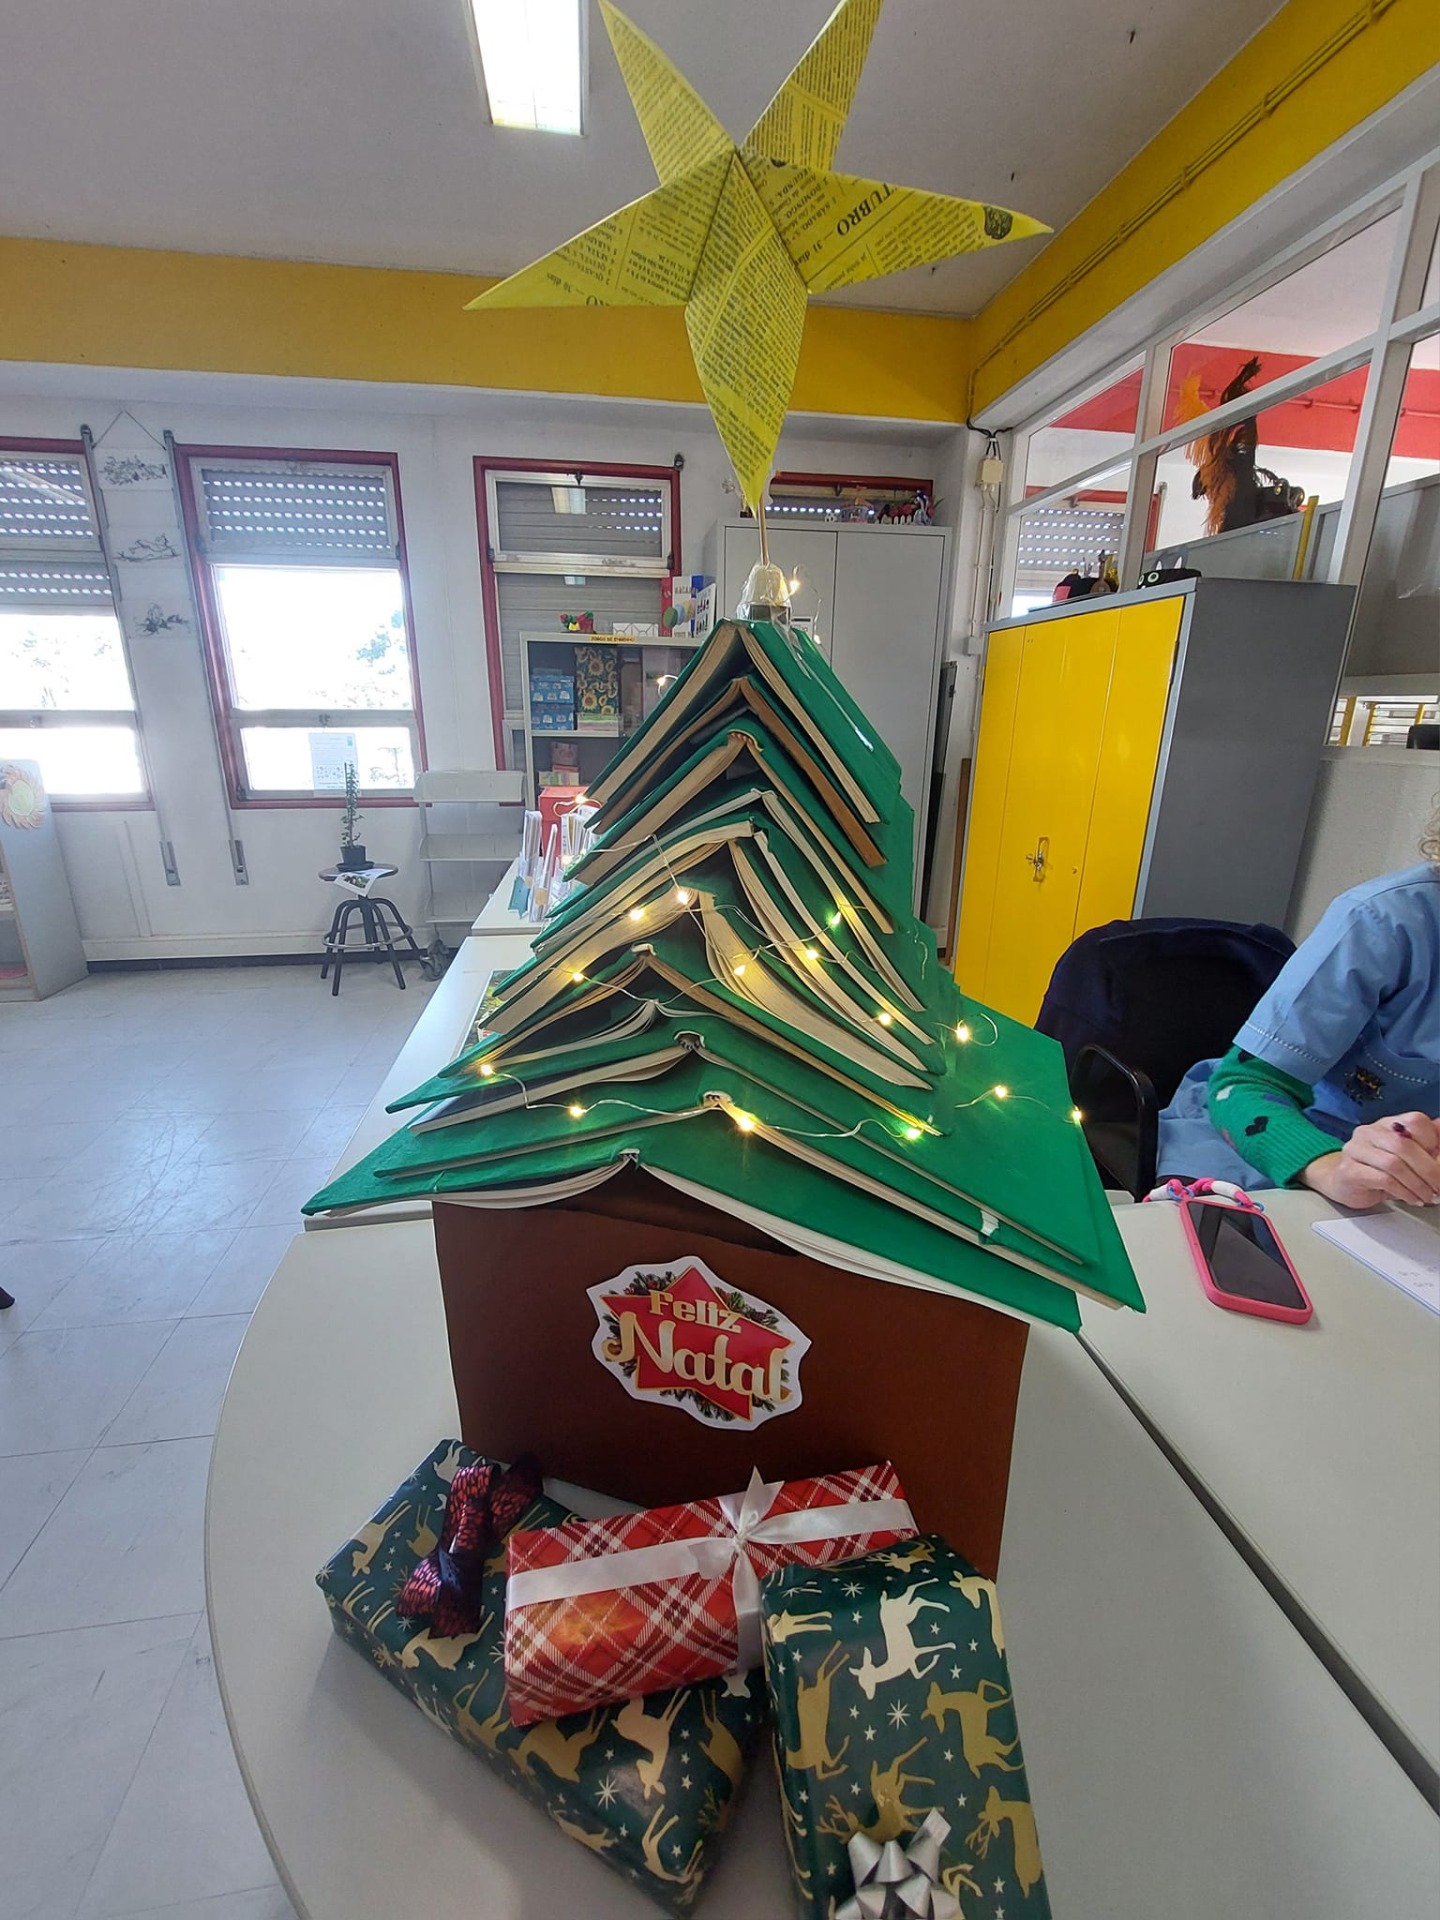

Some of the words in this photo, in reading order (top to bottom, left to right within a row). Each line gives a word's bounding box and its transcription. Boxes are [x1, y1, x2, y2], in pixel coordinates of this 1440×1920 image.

[836, 182, 897, 236] TUBRO
[649, 1289, 742, 1334] Feliz
[601, 1311, 793, 1403] Natal
